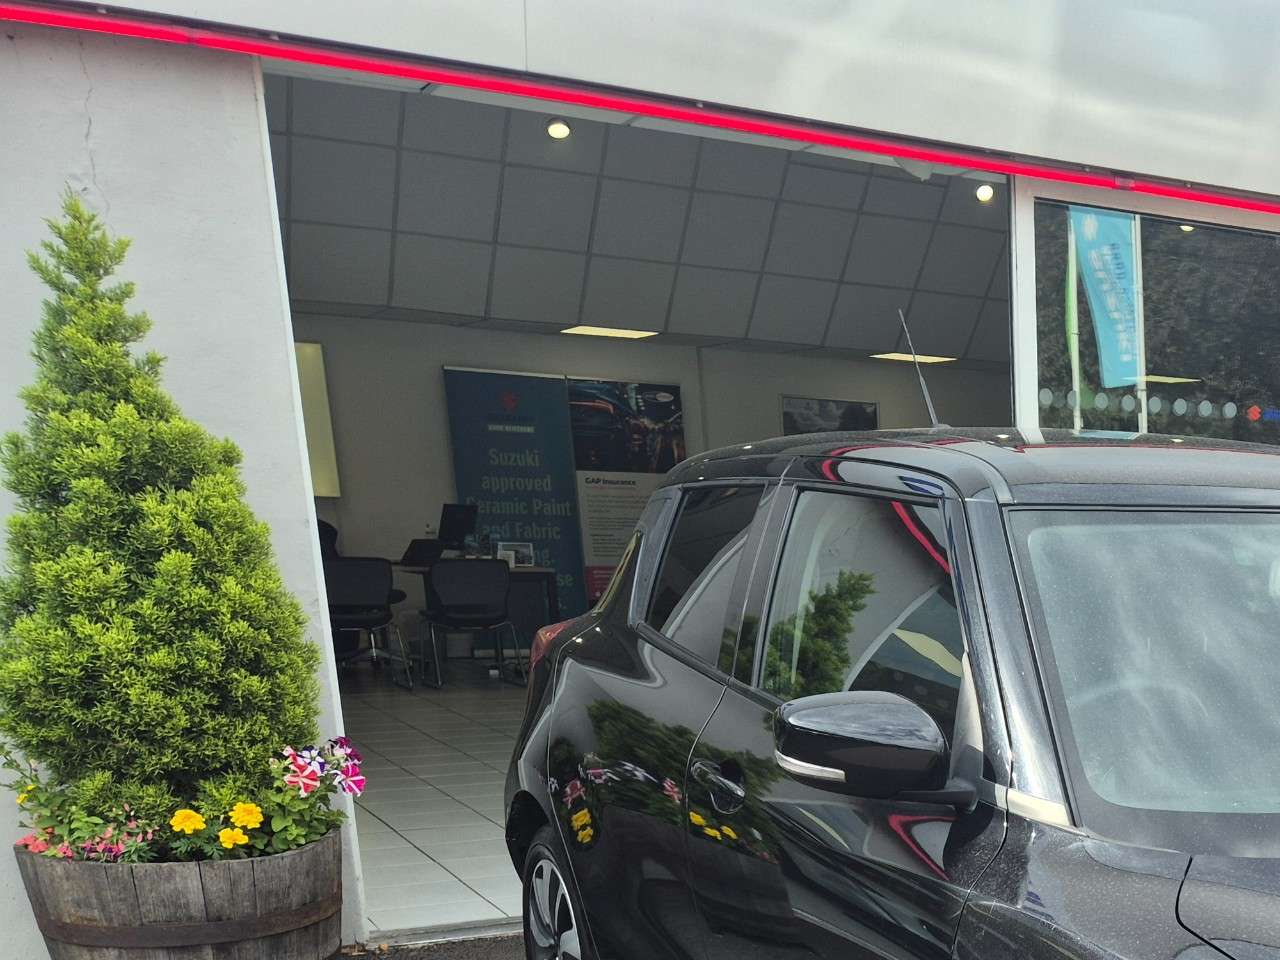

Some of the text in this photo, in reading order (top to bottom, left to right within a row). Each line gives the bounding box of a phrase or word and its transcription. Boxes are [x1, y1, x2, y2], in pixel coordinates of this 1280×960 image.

[489, 449, 540, 467] Suzuki
[481, 474, 552, 493] approved
[533, 499, 572, 517] Paint
[514, 521, 561, 539] Fabric
